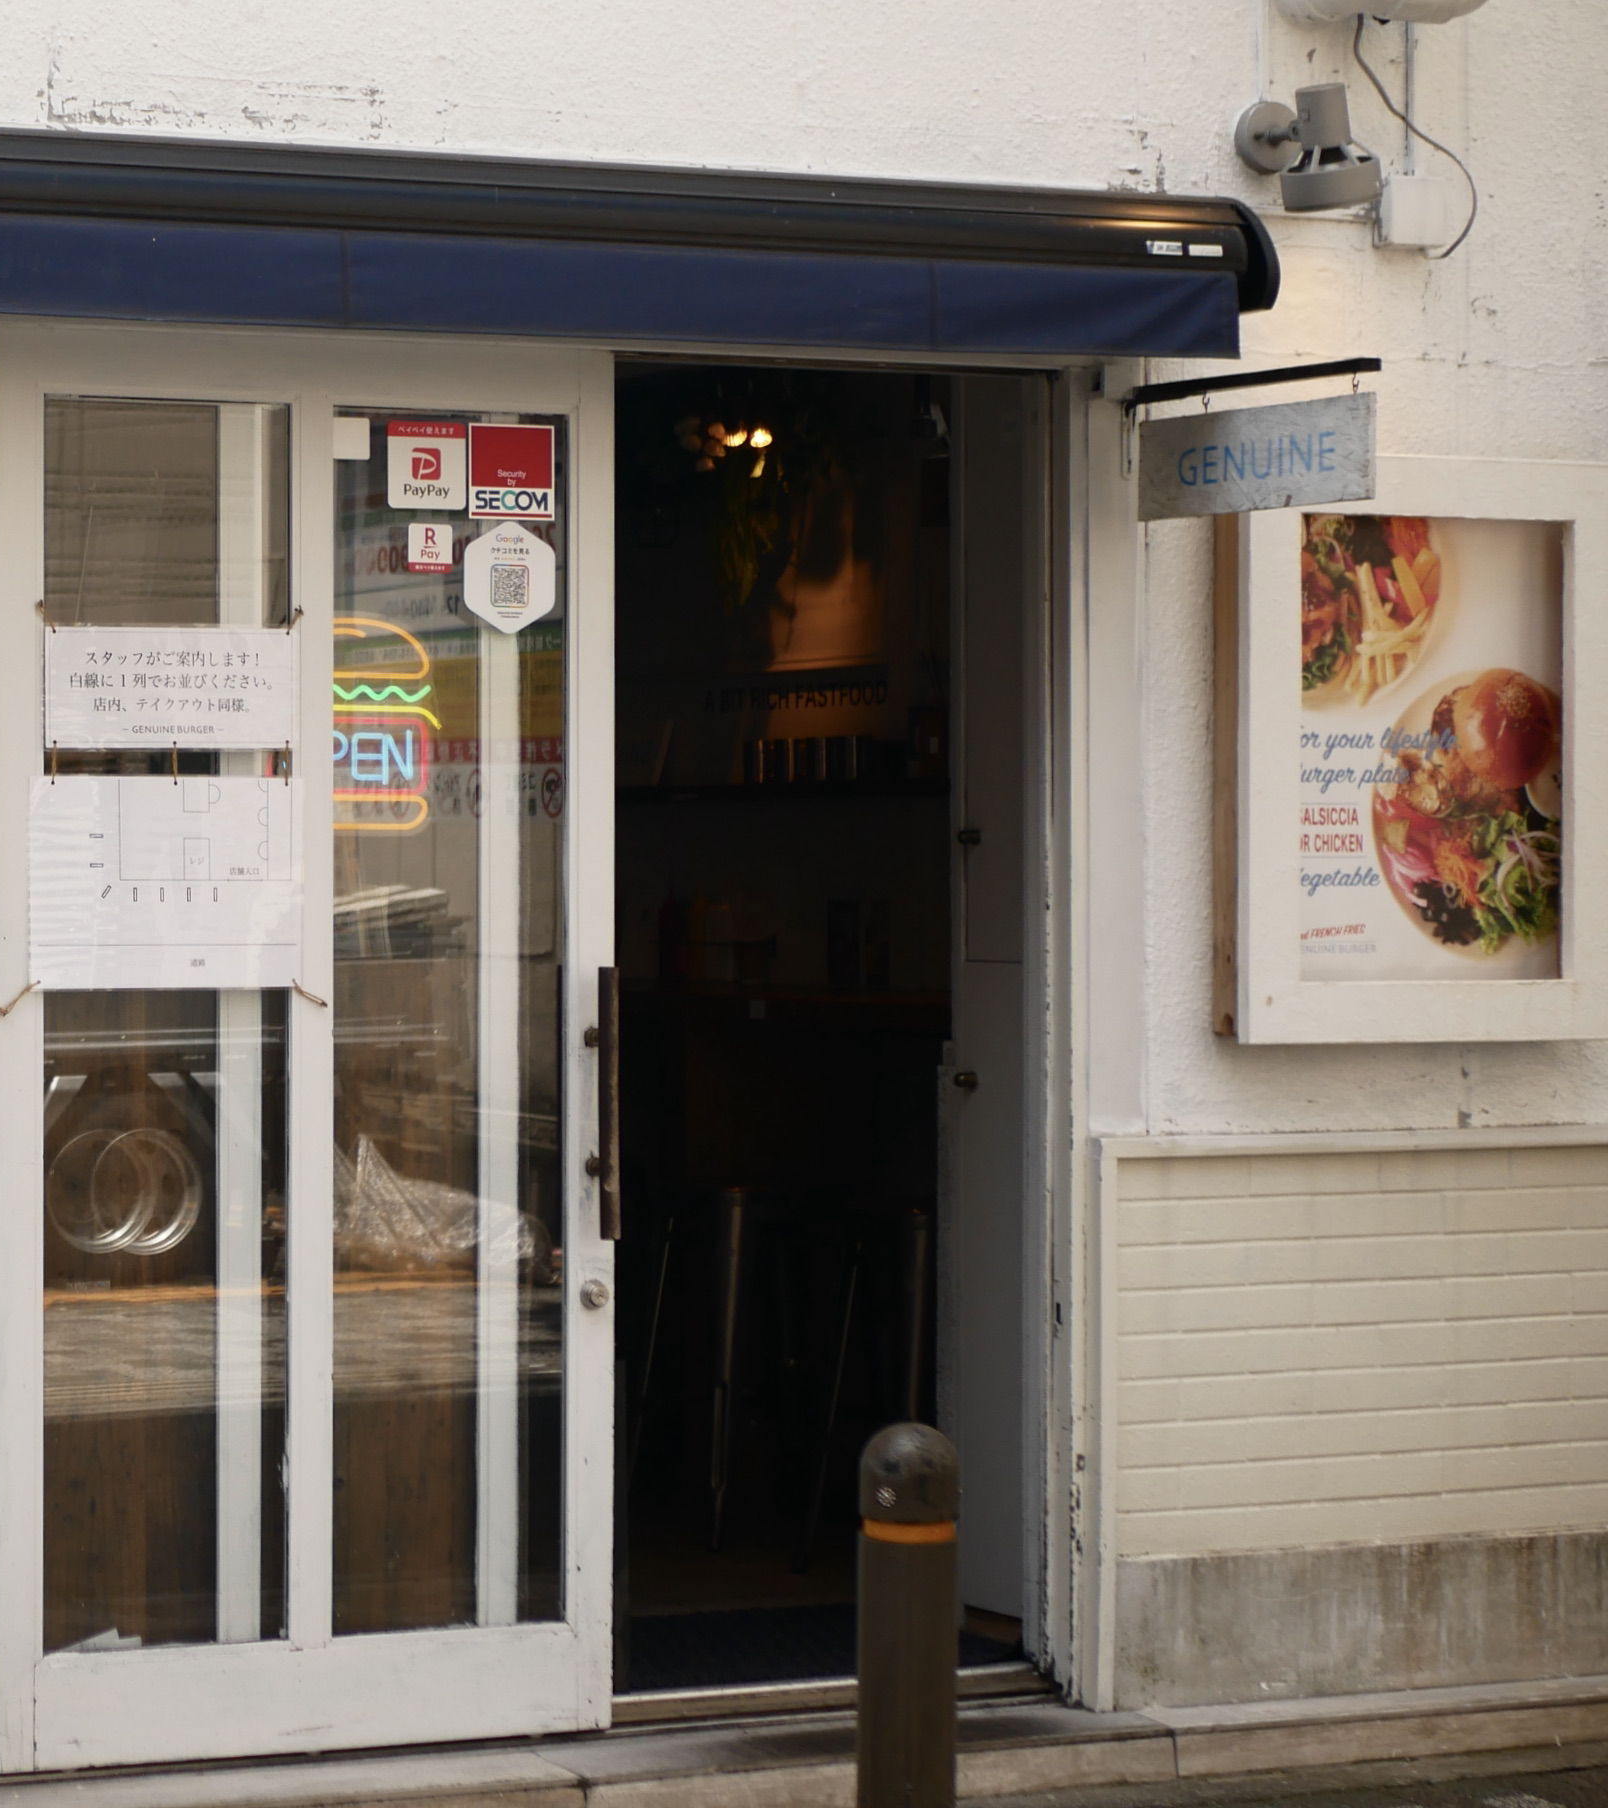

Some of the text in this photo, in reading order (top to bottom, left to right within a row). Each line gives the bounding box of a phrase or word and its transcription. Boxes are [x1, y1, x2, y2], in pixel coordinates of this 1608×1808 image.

[1178, 431, 1336, 487] GENUINE
[497, 469, 527, 479] Security
[507, 478, 517, 487] by
[404, 483, 450, 499] PayPay
[475, 490, 548, 511] SECOM
[496, 533, 524, 544] Google
[421, 549, 440, 560] Pay
[750, 684, 789, 712] RICH
[795, 680, 888, 710] FASTFOOD
[93, 698, 250, 713] 店内、テイクアウト同様。
[132, 725, 215, 734] GENUINE BURGER
[1300, 726, 1321, 748] or
[1323, 733, 1375, 760] your
[1300, 762, 1410, 794] urger plate
[1300, 833, 1364, 852] R CHICKEN
[189, 856, 205, 865] レジ
[229, 867, 260, 876] 店舗入口
[1300, 865, 1381, 897] egetable
